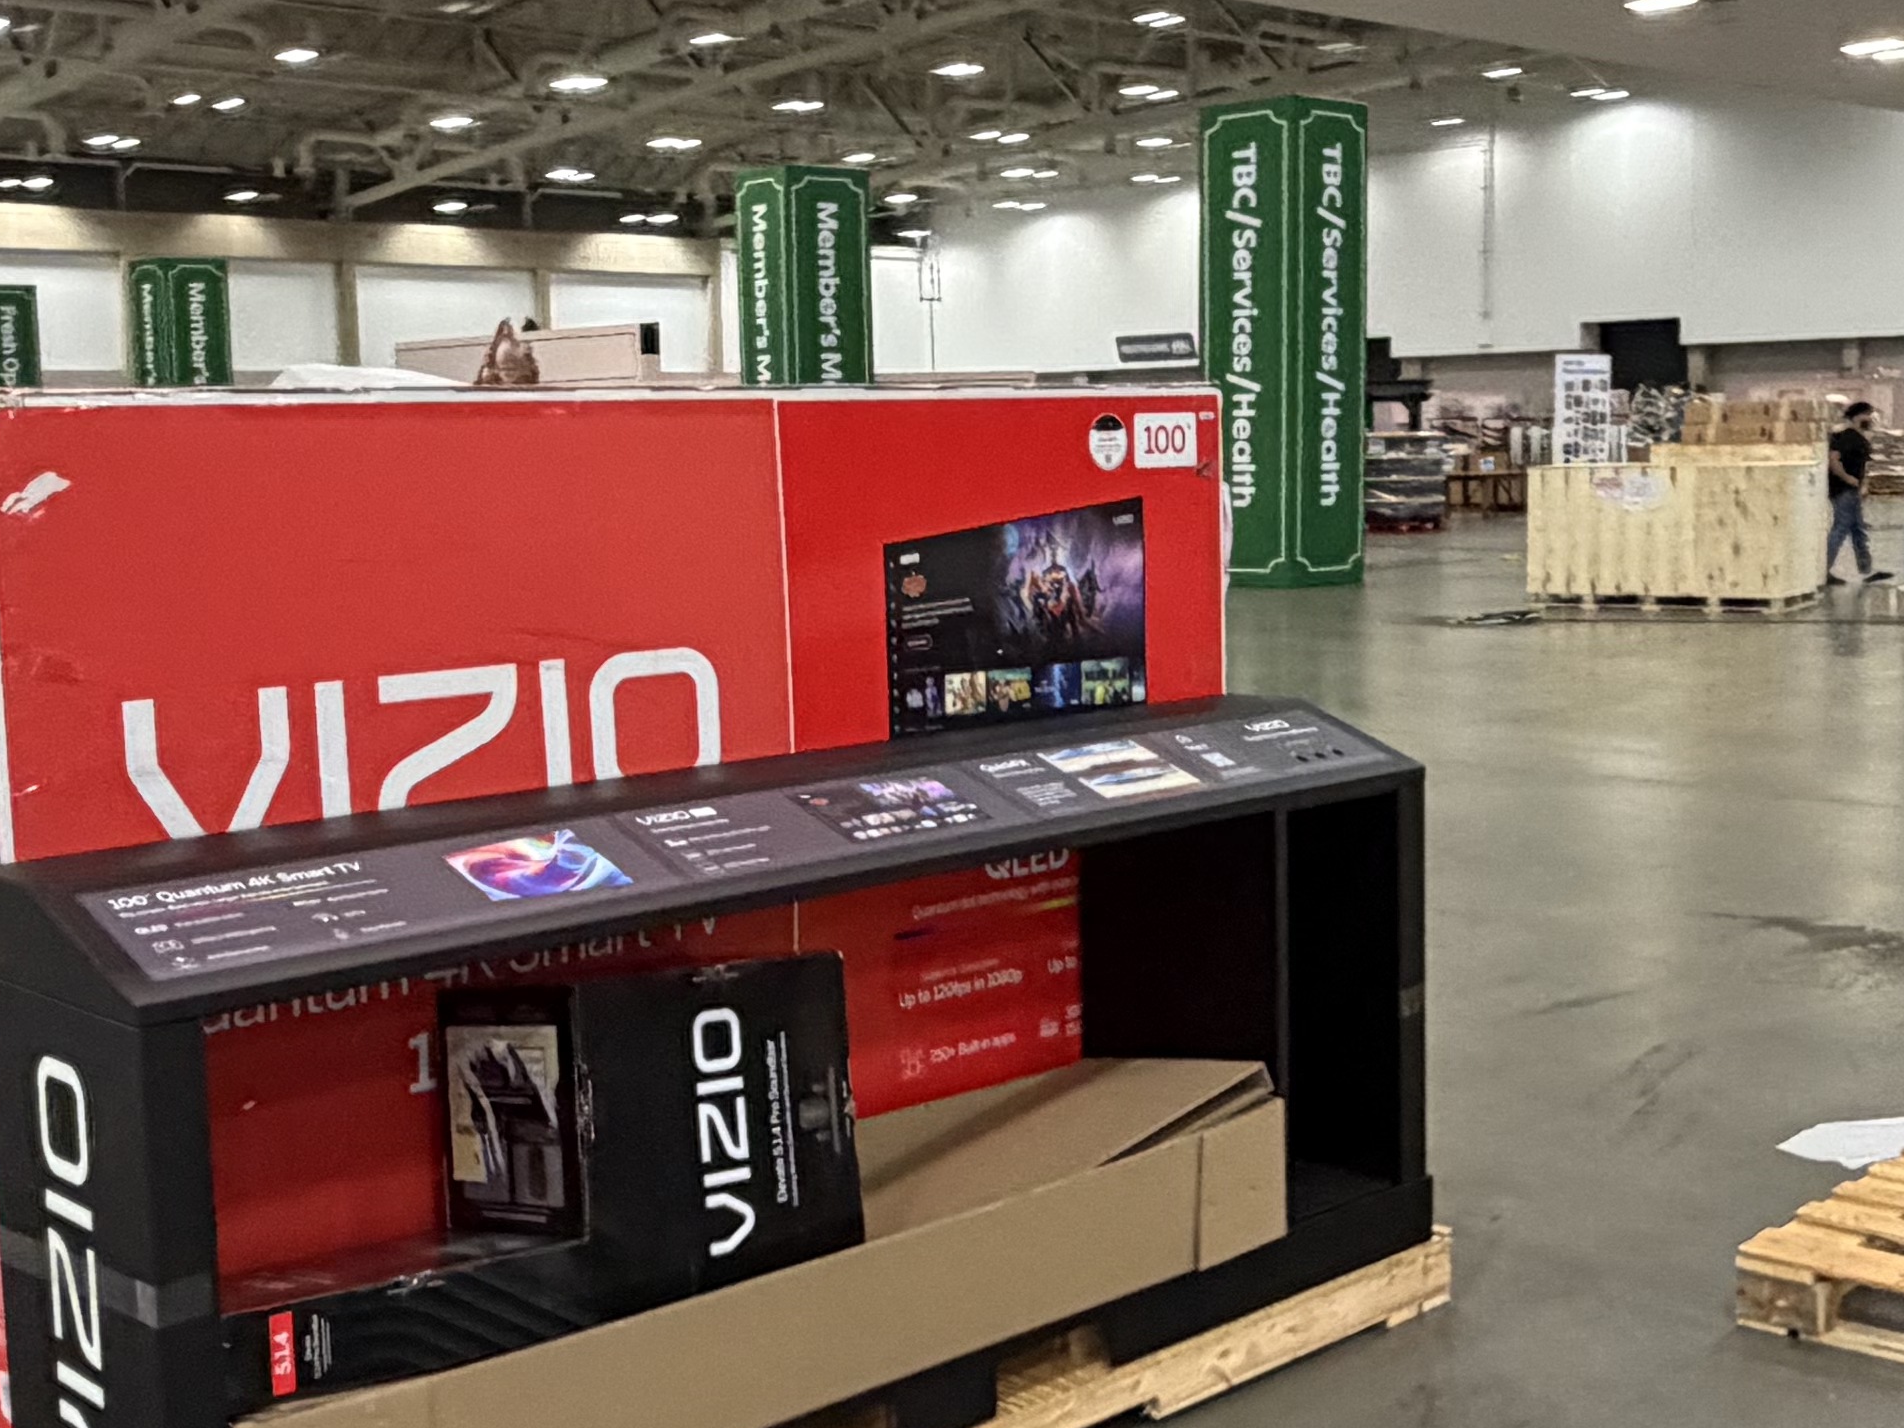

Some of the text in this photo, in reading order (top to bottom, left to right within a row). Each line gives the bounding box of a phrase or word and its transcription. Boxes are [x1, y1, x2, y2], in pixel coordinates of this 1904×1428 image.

[752, 204, 772, 386] Member's M
[817, 202, 843, 385] Member's M
[1226, 142, 1262, 508] TBC/Services/Health
[1316, 143, 1347, 508] TBC/Services/Health
[122, 647, 722, 840] VIZIO
[155, 880, 246, 903] Quantum
[248, 874, 277, 888] 4K
[277, 866, 335, 883] Smart
[334, 860, 360, 873] TV
[692, 1007, 756, 1257] VIZIO
[769, 1102, 781, 1124] Pro
